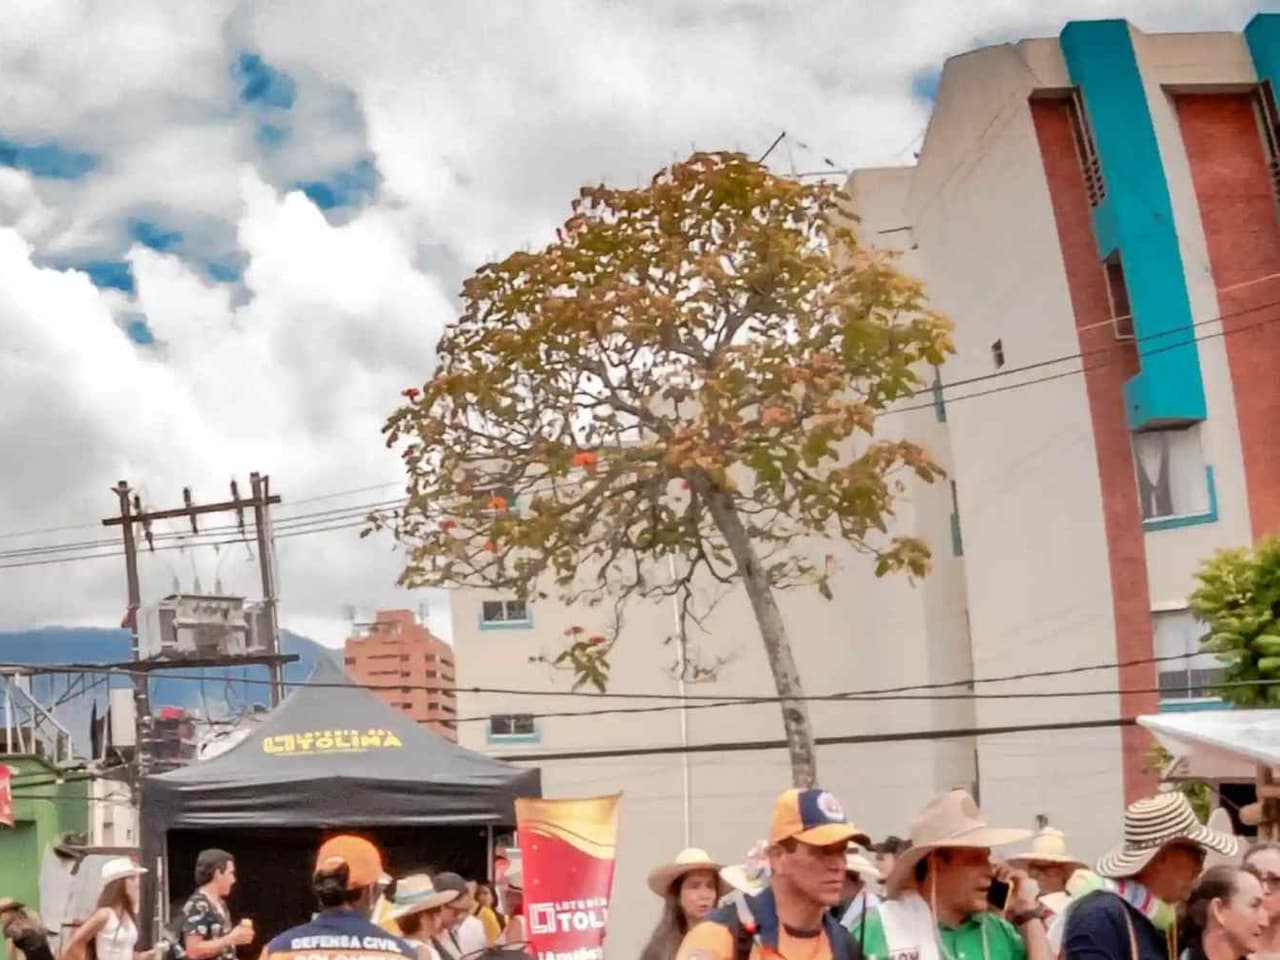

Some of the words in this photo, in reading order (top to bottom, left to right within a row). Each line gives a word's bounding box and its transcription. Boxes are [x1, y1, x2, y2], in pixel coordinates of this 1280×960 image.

[297, 733, 403, 749] TOLIMA
[291, 935, 361, 949] DEFENSA
[362, 937, 402, 952] CIVIL
